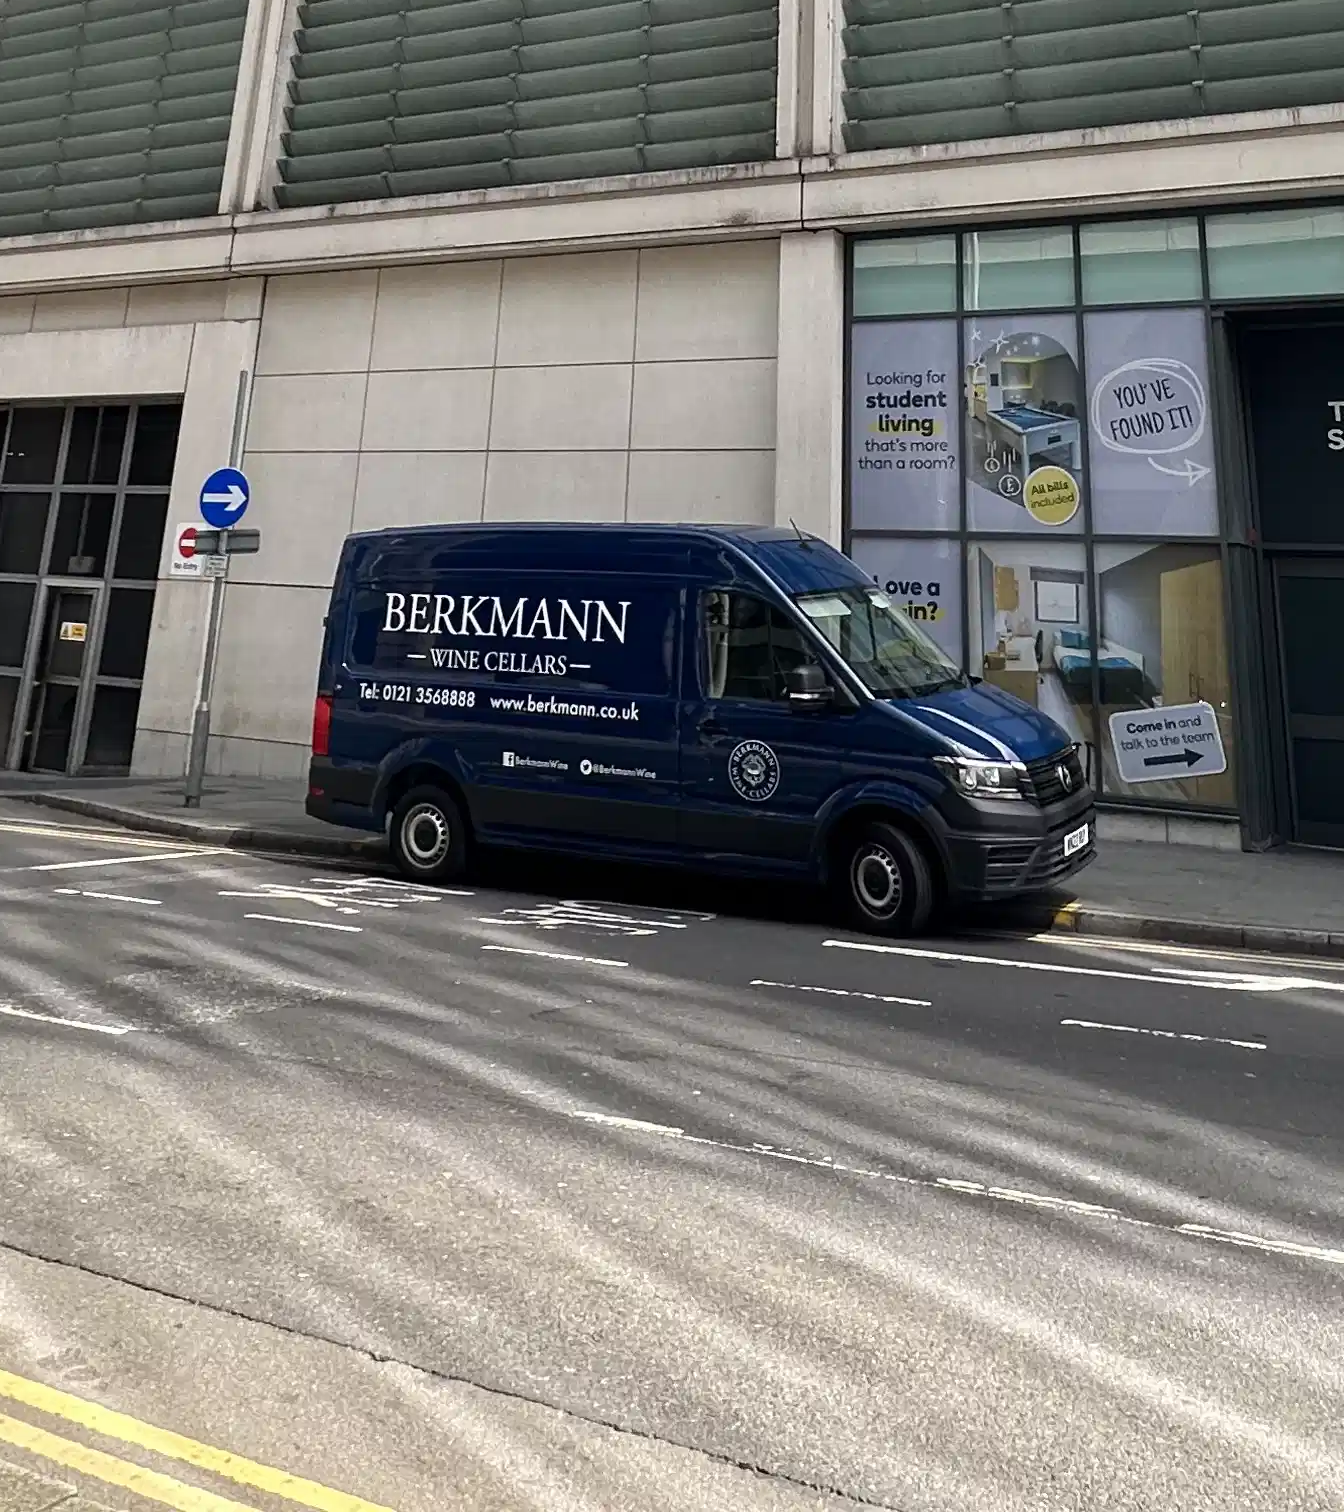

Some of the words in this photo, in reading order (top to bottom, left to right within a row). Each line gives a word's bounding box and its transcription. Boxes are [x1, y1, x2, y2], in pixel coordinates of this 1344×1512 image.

[866, 371, 923, 388] Looking
[926, 369, 946, 384] for
[866, 390, 947, 409] student
[1113, 378, 1176, 409] YOU'VE
[878, 413, 934, 437] living
[1110, 411, 1165, 441] FOUND
[1167, 404, 1194, 431] IT!
[864, 438, 907, 452] that's
[910, 441, 948, 452] more
[858, 456, 892, 470] than
[896, 459, 905, 469] a
[909, 455, 956, 469] room?
[1032, 484, 1046, 495] All
[1047, 481, 1069, 492] bills
[1030, 492, 1075, 508] included
[927, 582, 940, 596] a
[382, 592, 632, 645] BERKMANN
[430, 648, 480, 670] WINE
[484, 651, 568, 676] CELLARS
[360, 682, 380, 700] Tel:
[382, 685, 412, 702] 0121
[416, 687, 476, 708] 3568888
[490, 694, 640, 721] www.berkmann.co.uk
[1126, 722, 1163, 734] Come
[1165, 718, 1176, 730] in
[1178, 715, 1201, 727] and
[1120, 737, 1144, 751] talk
[1145, 737, 1158, 748] to
[1160, 734, 1180, 747] the
[1182, 731, 1215, 744] team
